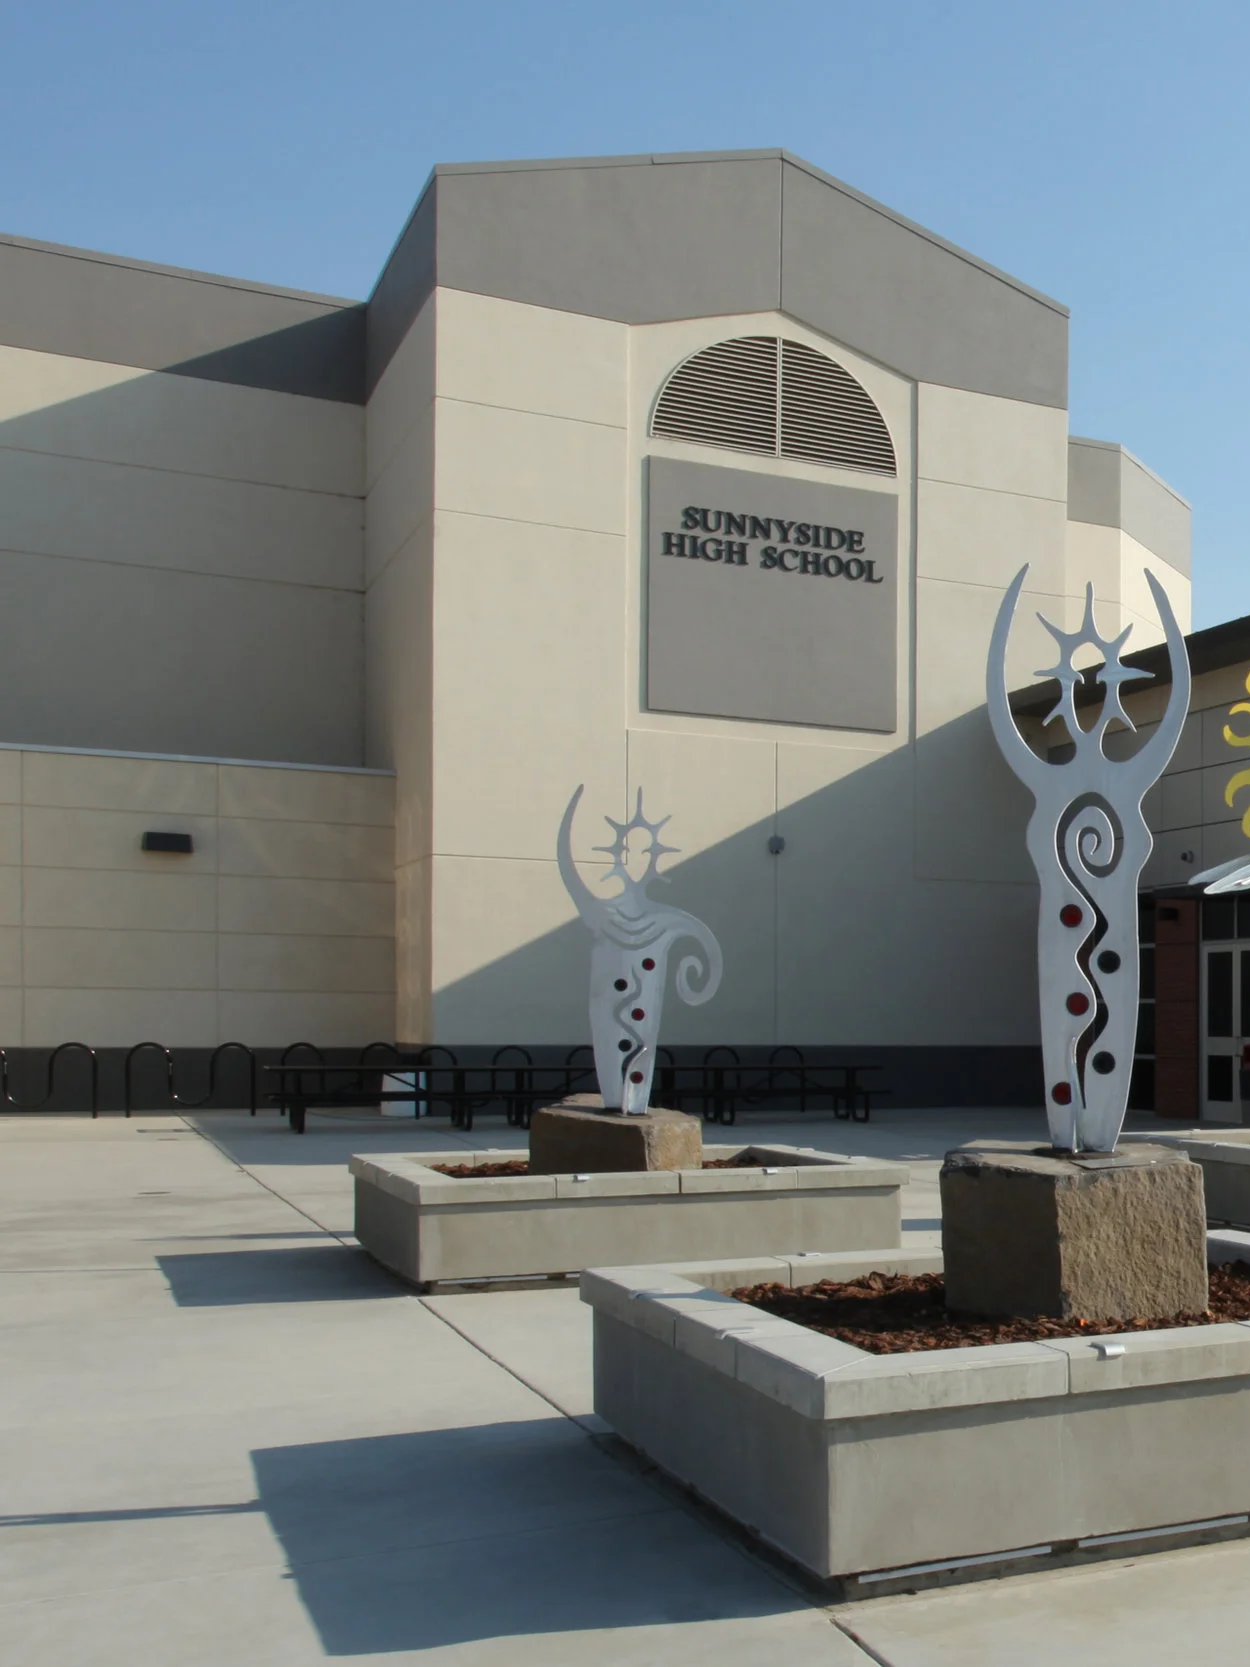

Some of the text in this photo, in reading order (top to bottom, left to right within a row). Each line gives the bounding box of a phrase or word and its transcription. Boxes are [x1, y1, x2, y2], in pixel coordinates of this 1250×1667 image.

[681, 506, 865, 553] SUNNYSIDE
[661, 532, 884, 584] HIGH SCHOOL
